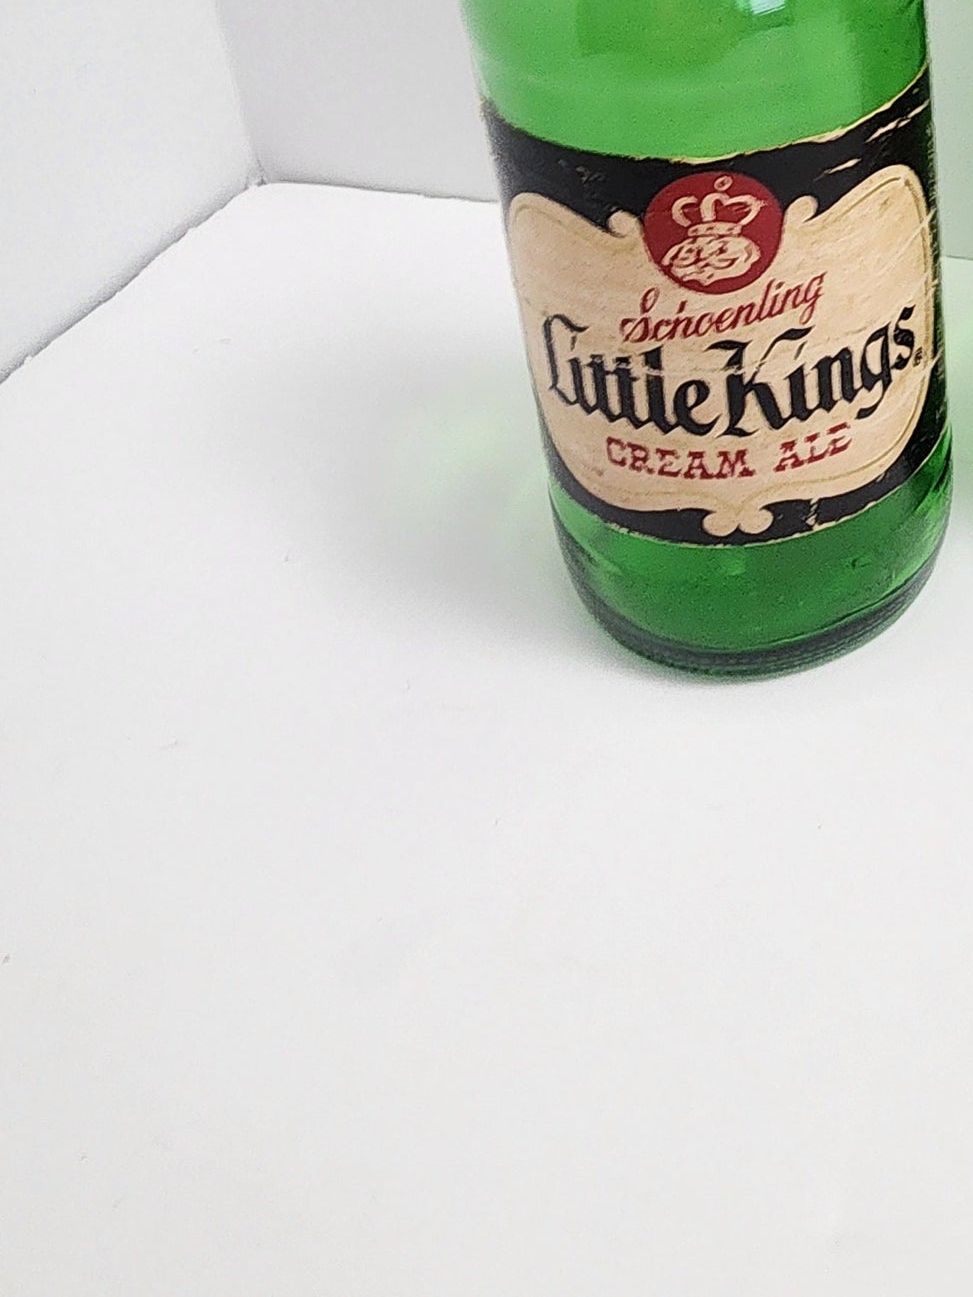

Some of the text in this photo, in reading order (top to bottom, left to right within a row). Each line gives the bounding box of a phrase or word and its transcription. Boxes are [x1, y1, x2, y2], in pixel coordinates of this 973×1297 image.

[621, 272, 827, 343] Schoenling
[605, 422, 854, 479] CREAM ALE
